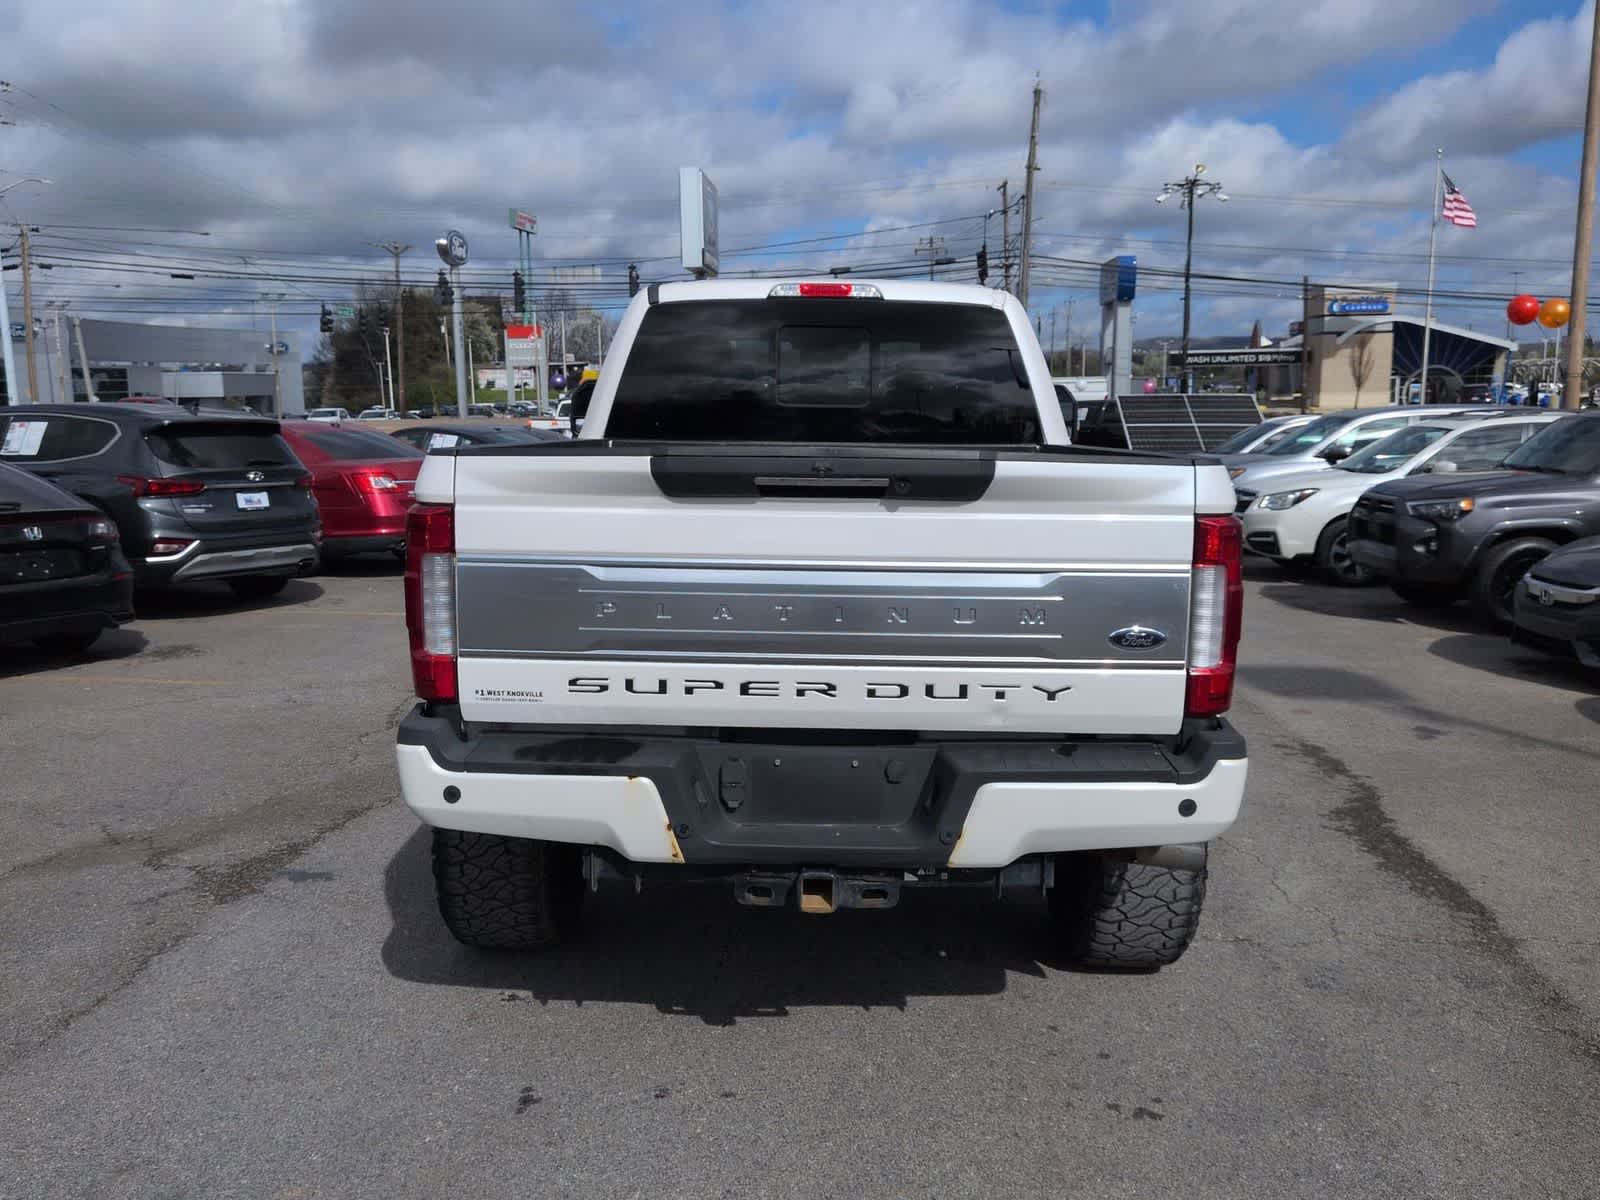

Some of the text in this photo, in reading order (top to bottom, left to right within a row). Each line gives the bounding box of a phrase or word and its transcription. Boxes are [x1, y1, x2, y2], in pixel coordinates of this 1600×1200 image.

[1211, 354, 1256, 363] UNLIMITED
[595, 602, 1048, 626] PLATINUM
[1120, 631, 1155, 646] Ford
[567, 676, 1073, 702] SUPER DUTY
